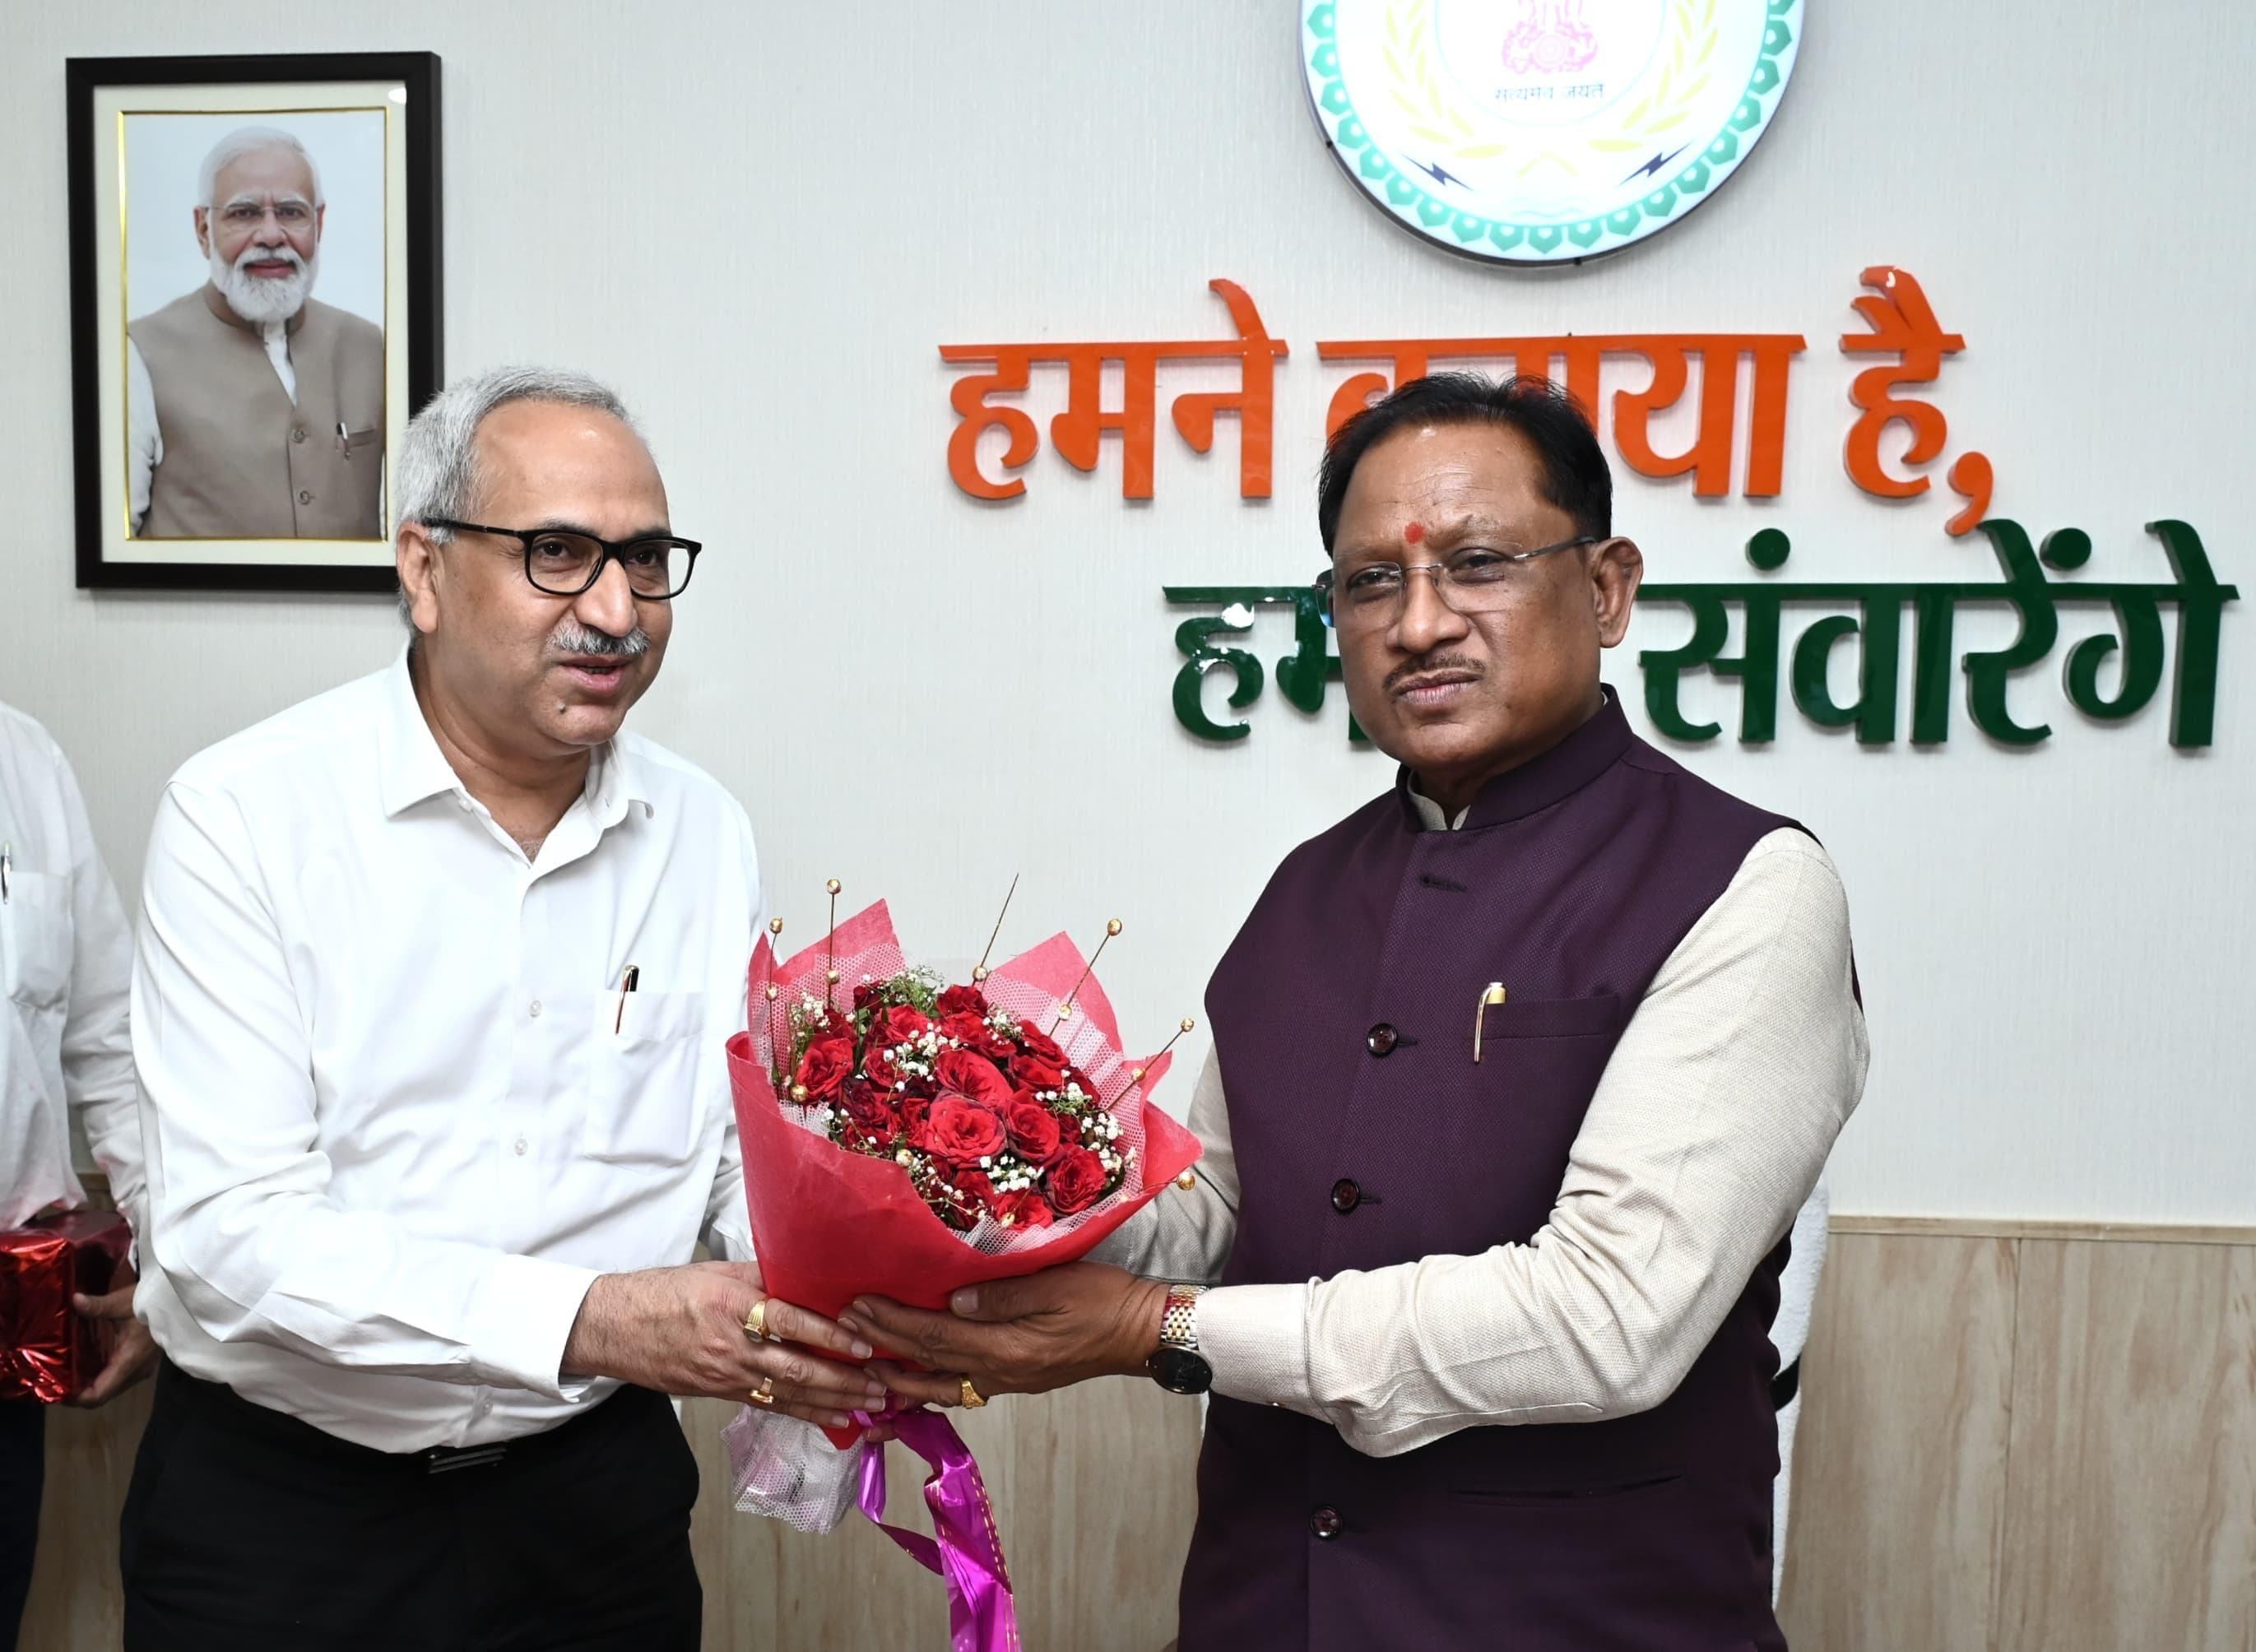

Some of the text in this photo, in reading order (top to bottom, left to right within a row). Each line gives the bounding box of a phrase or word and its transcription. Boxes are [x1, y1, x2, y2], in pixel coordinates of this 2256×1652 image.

[939, 279, 1289, 499] हमने
[1839, 266, 1994, 536] है,
[1635, 518, 2240, 747] संवारेंगे
